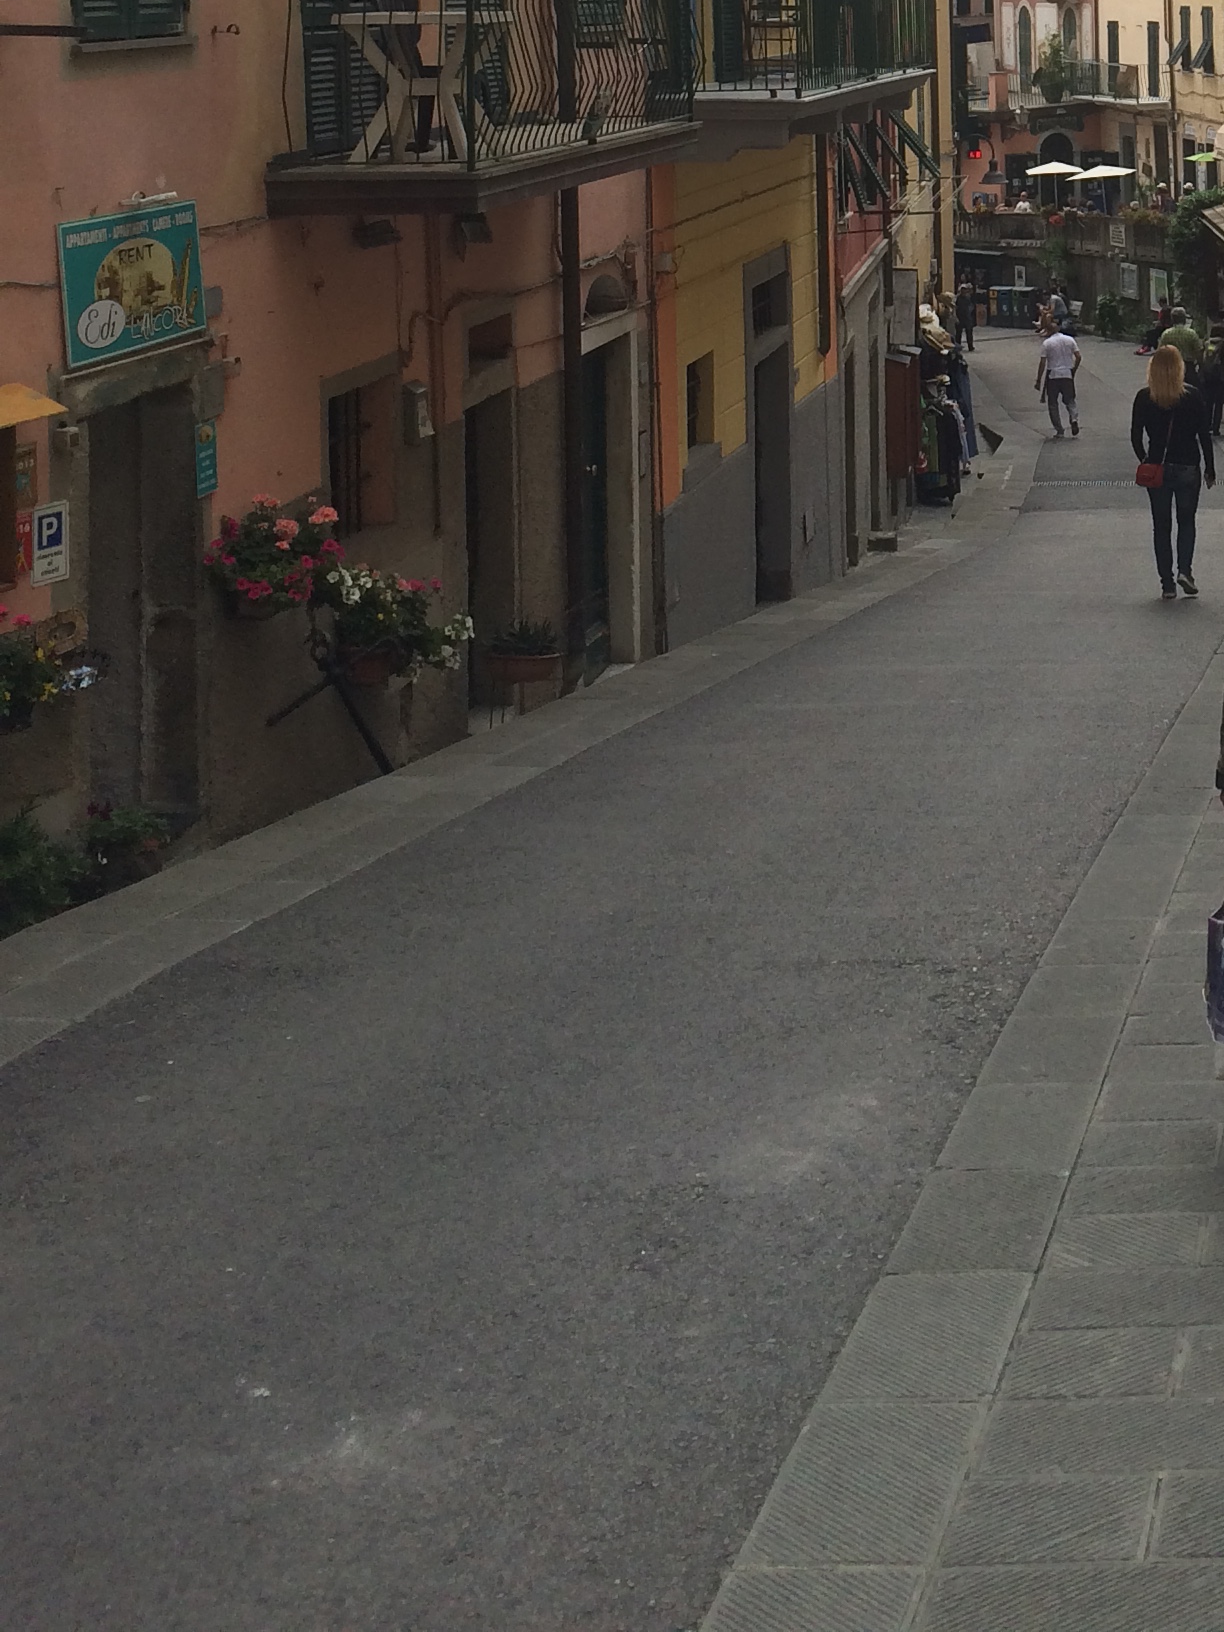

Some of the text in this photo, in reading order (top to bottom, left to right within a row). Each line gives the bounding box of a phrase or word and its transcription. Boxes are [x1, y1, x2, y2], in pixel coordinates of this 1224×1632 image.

[118, 243, 154, 265] RENT
[85, 304, 117, 344] Edi
[42, 516, 58, 546] P
